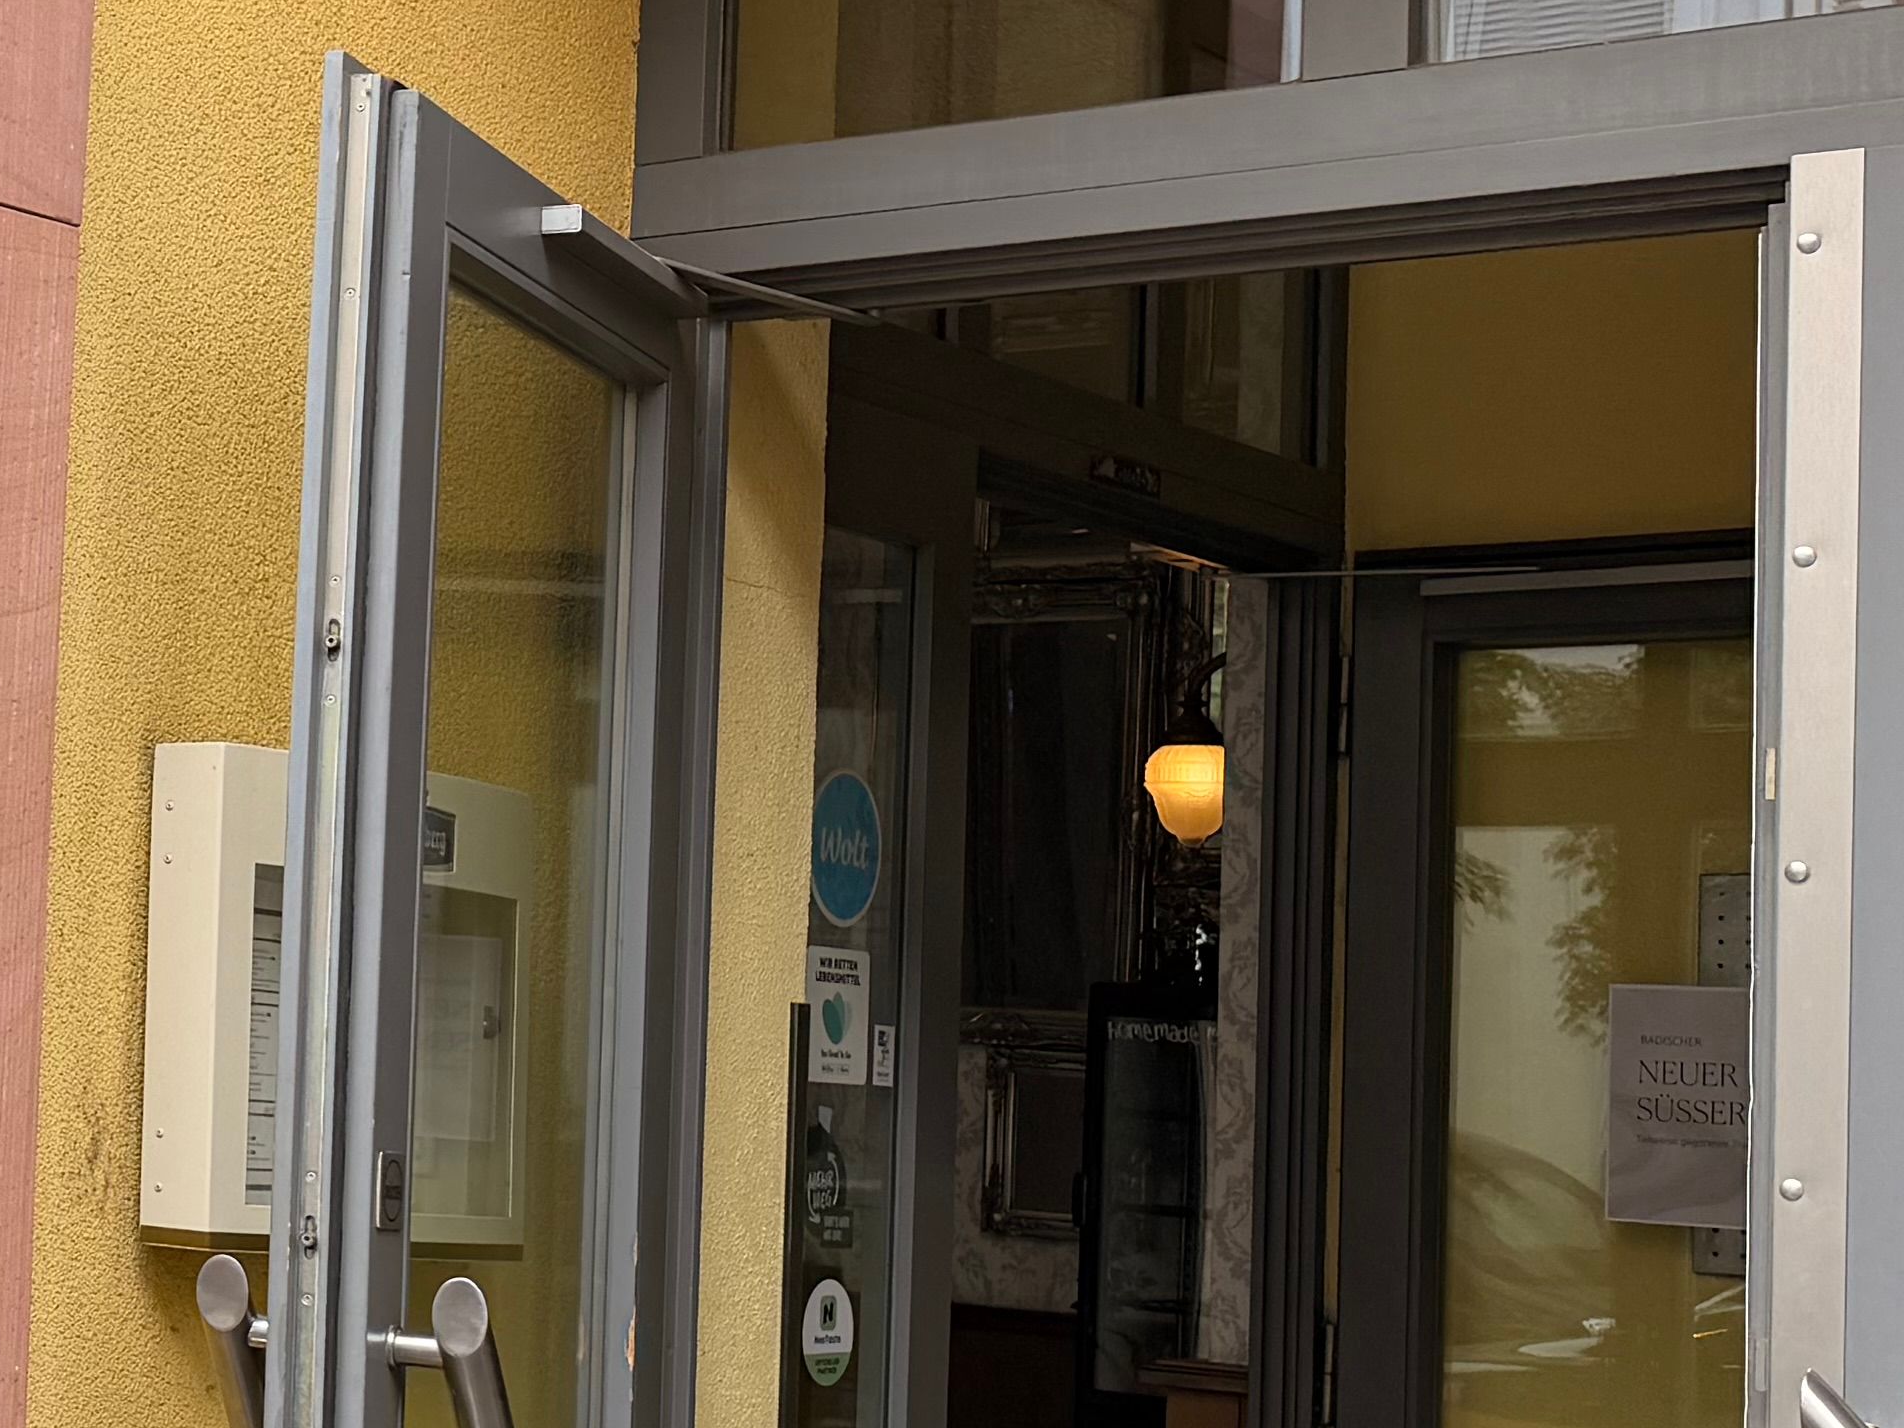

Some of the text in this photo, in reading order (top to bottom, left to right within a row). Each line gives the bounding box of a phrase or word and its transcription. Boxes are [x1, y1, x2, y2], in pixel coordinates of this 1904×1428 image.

[820, 825, 869, 870] Wolt
[1638, 1059, 1738, 1088] NEUER
[1636, 1093, 1746, 1126] SÜSSER
